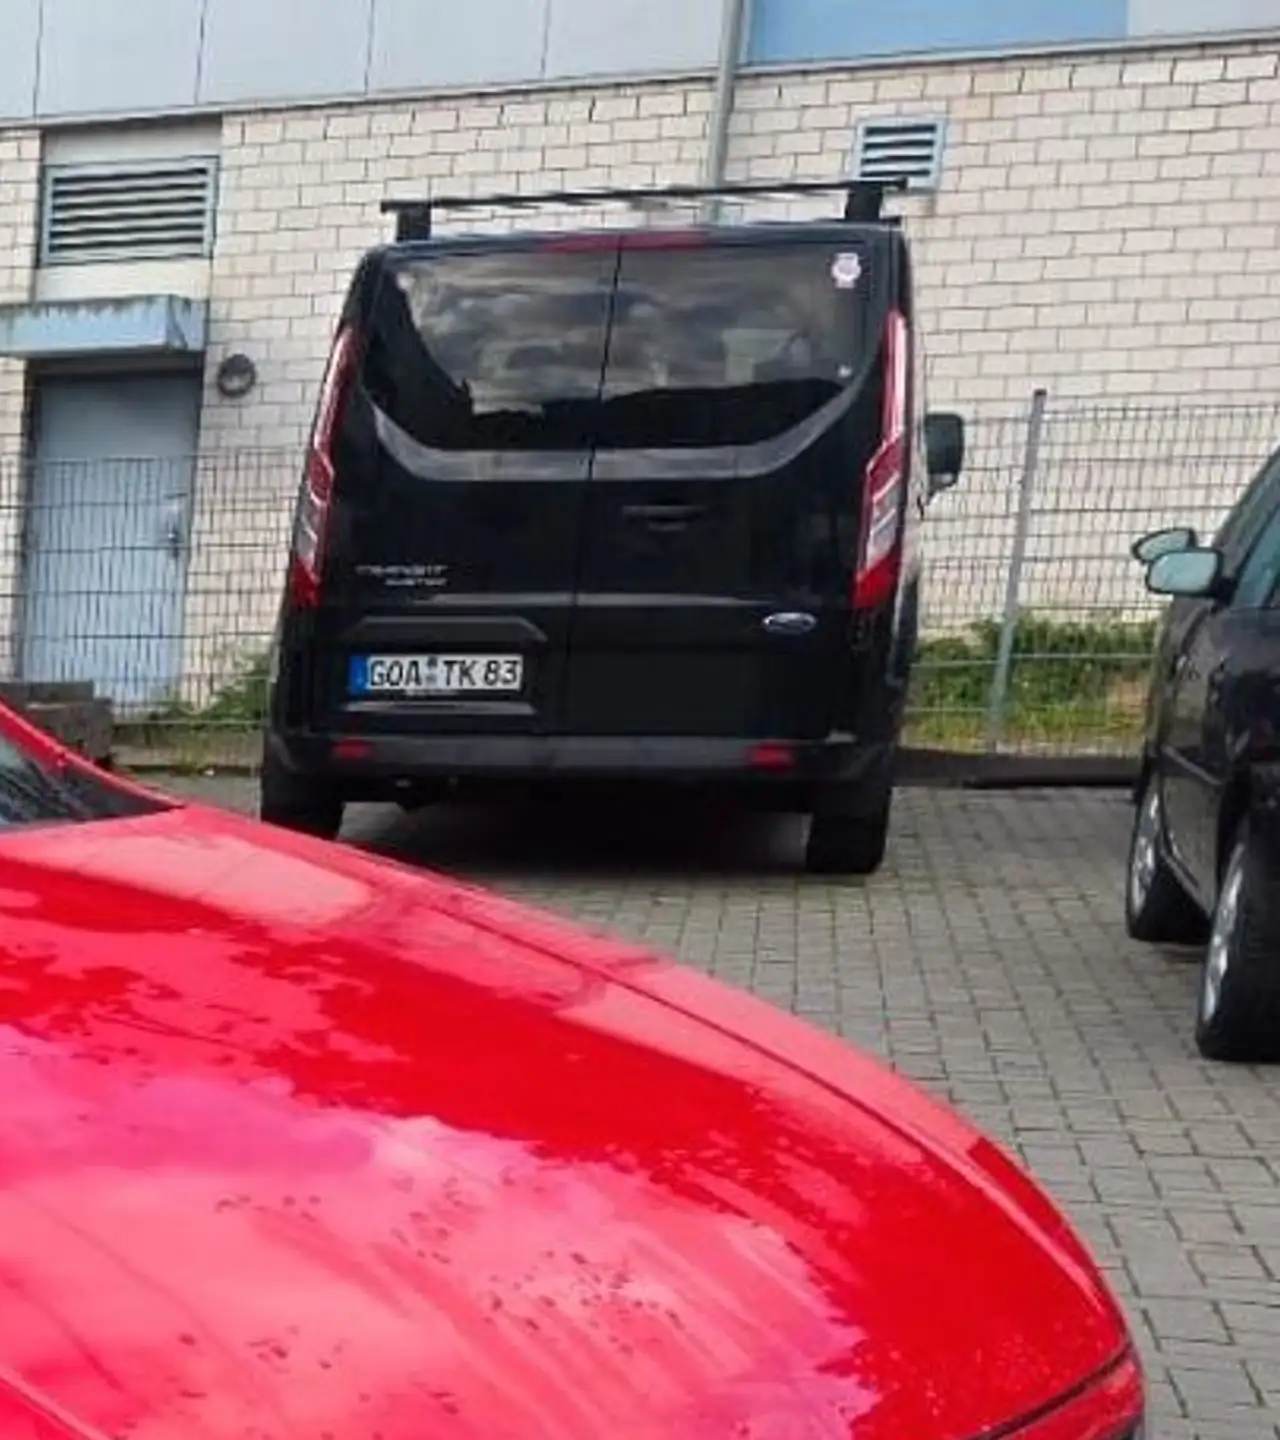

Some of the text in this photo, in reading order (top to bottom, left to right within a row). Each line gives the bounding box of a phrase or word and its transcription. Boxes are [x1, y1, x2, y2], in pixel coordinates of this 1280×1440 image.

[370, 659, 520, 687] GOA TK 83
